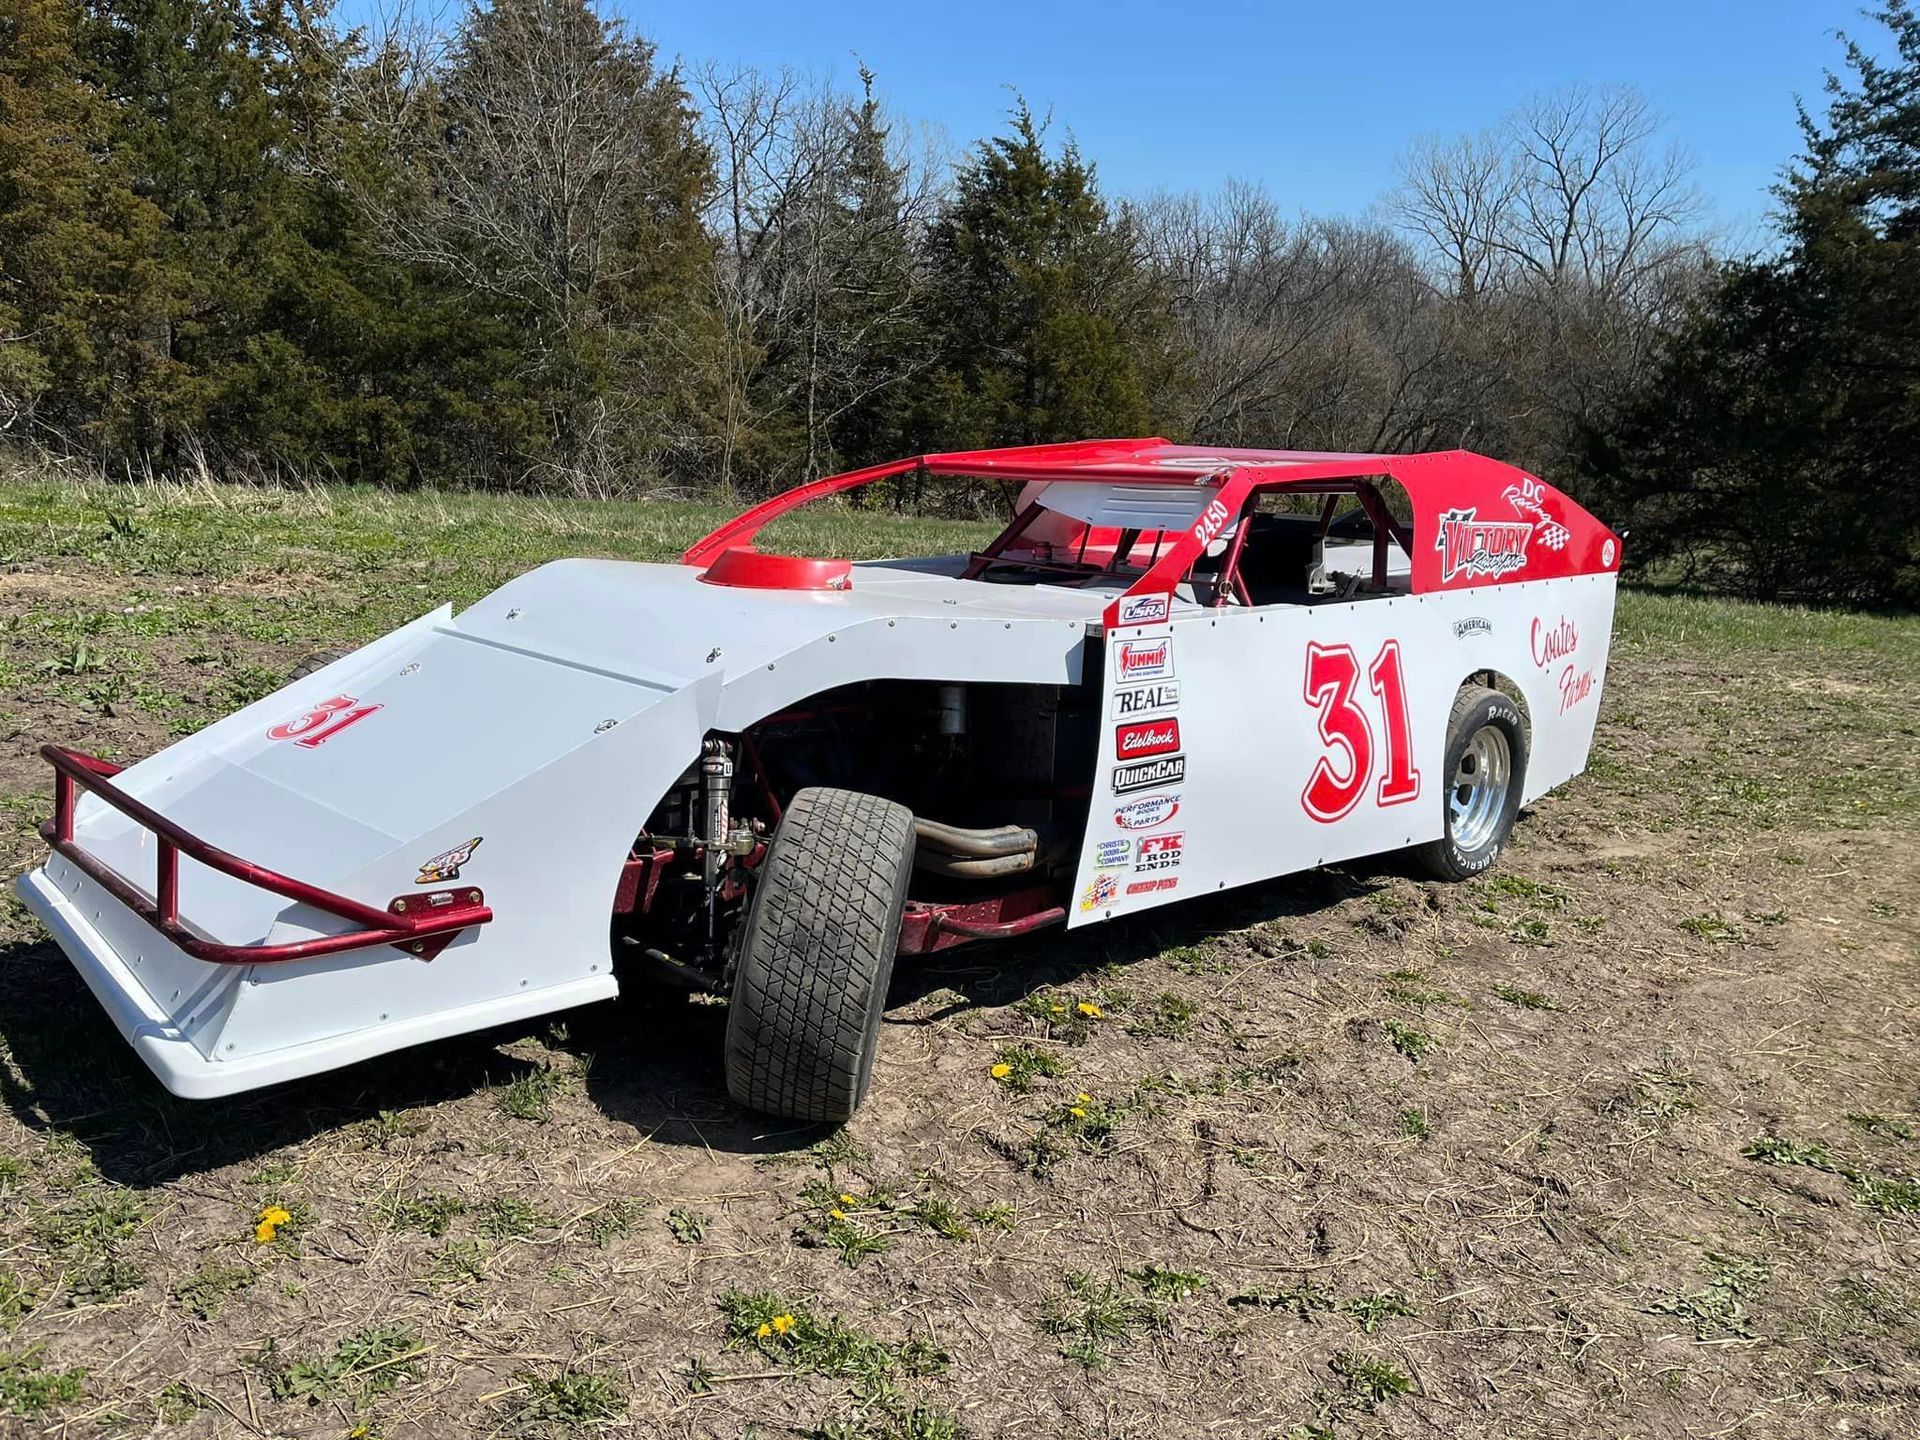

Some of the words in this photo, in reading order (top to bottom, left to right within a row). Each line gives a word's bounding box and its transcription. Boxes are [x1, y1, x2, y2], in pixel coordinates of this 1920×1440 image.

[1522, 478, 1546, 504] DC
[1195, 500, 1229, 547] 2450
[1444, 521, 1532, 581] VICTORY
[1123, 602, 1166, 620] USRA
[1456, 619, 1492, 637] AMERICAN
[1530, 615, 1579, 668] Coates
[1120, 643, 1167, 680] SUMMIT
[1115, 687, 1178, 713] REAL
[1559, 664, 1593, 717] Farms
[266, 694, 385, 749] 31
[1487, 705, 1519, 726] RACER
[1122, 728, 1175, 751] Edelbrock
[1301, 638, 1421, 824] 31
[1114, 794, 1182, 815] PERFORMANCE
[1133, 815, 1162, 827] PARTS
[1141, 835, 1182, 853] FK
[1145, 850, 1182, 862] ROD
[1134, 859, 1181, 873] ENDS
